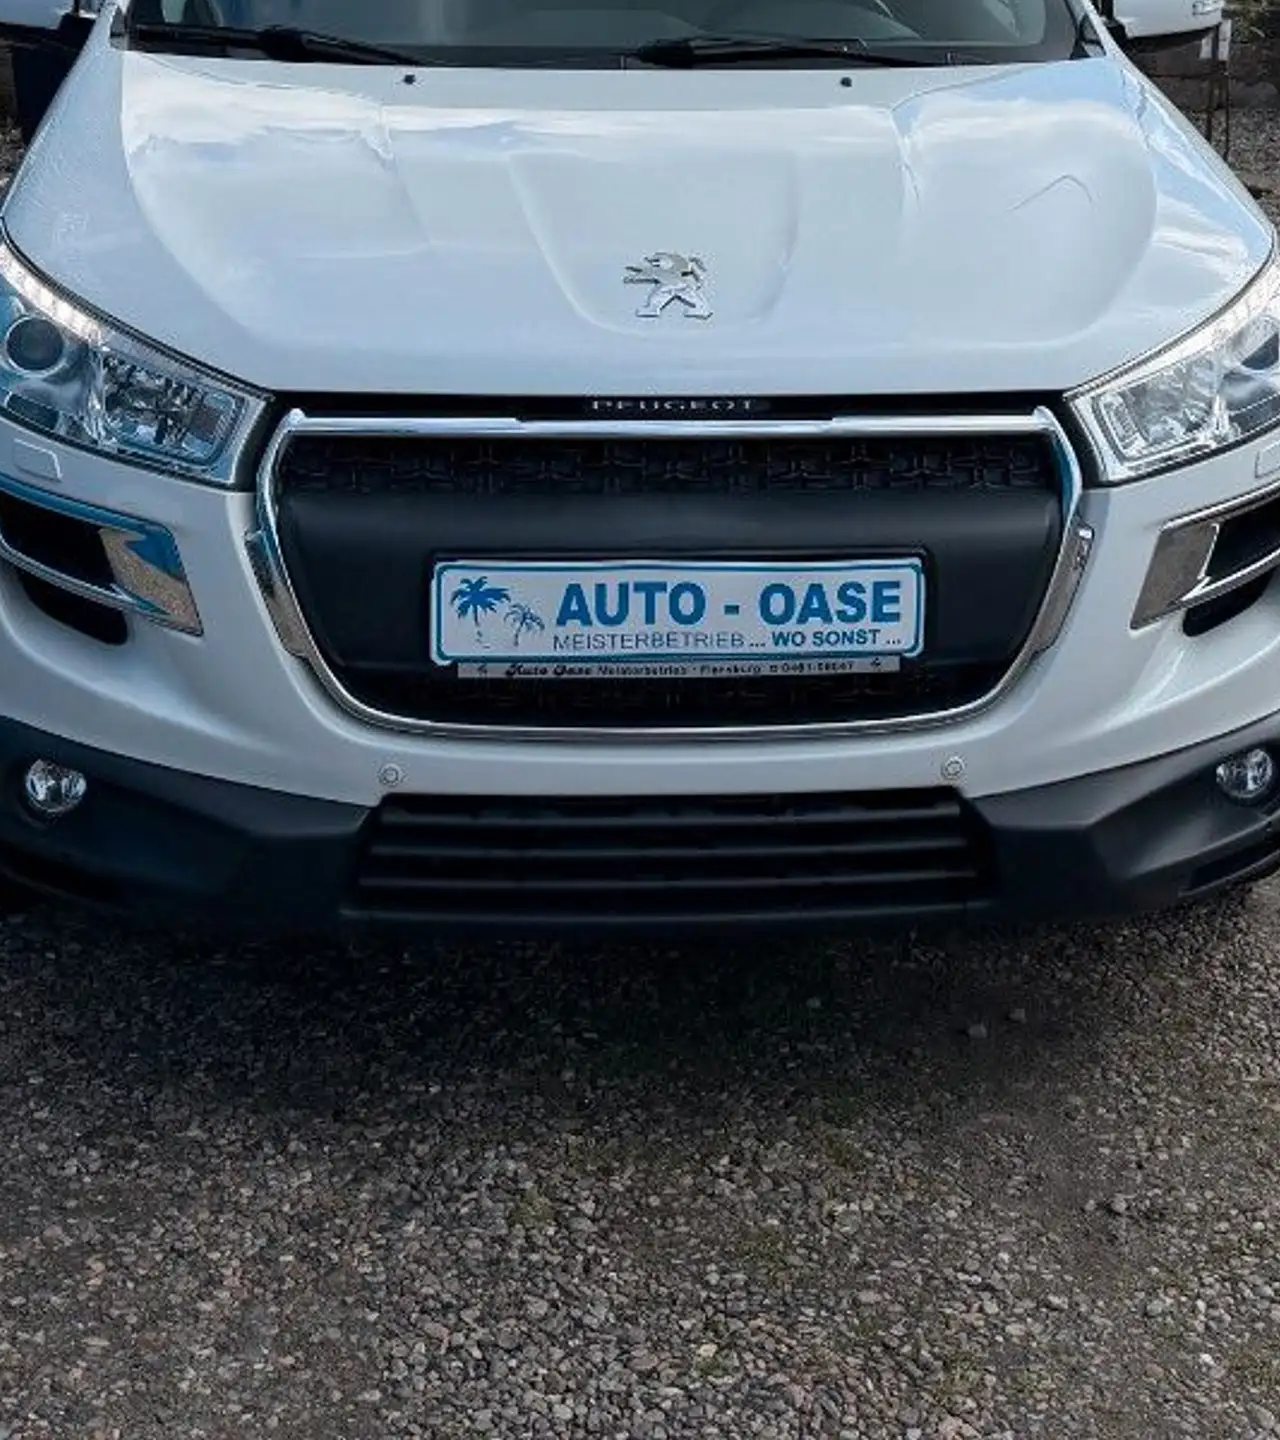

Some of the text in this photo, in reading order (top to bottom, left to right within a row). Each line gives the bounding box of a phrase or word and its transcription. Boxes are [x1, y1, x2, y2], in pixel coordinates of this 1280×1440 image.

[556, 581, 706, 627] AUTO
[759, 580, 901, 626] OASE
[771, 630, 807, 648] WO
[812, 628, 881, 646] SONST
